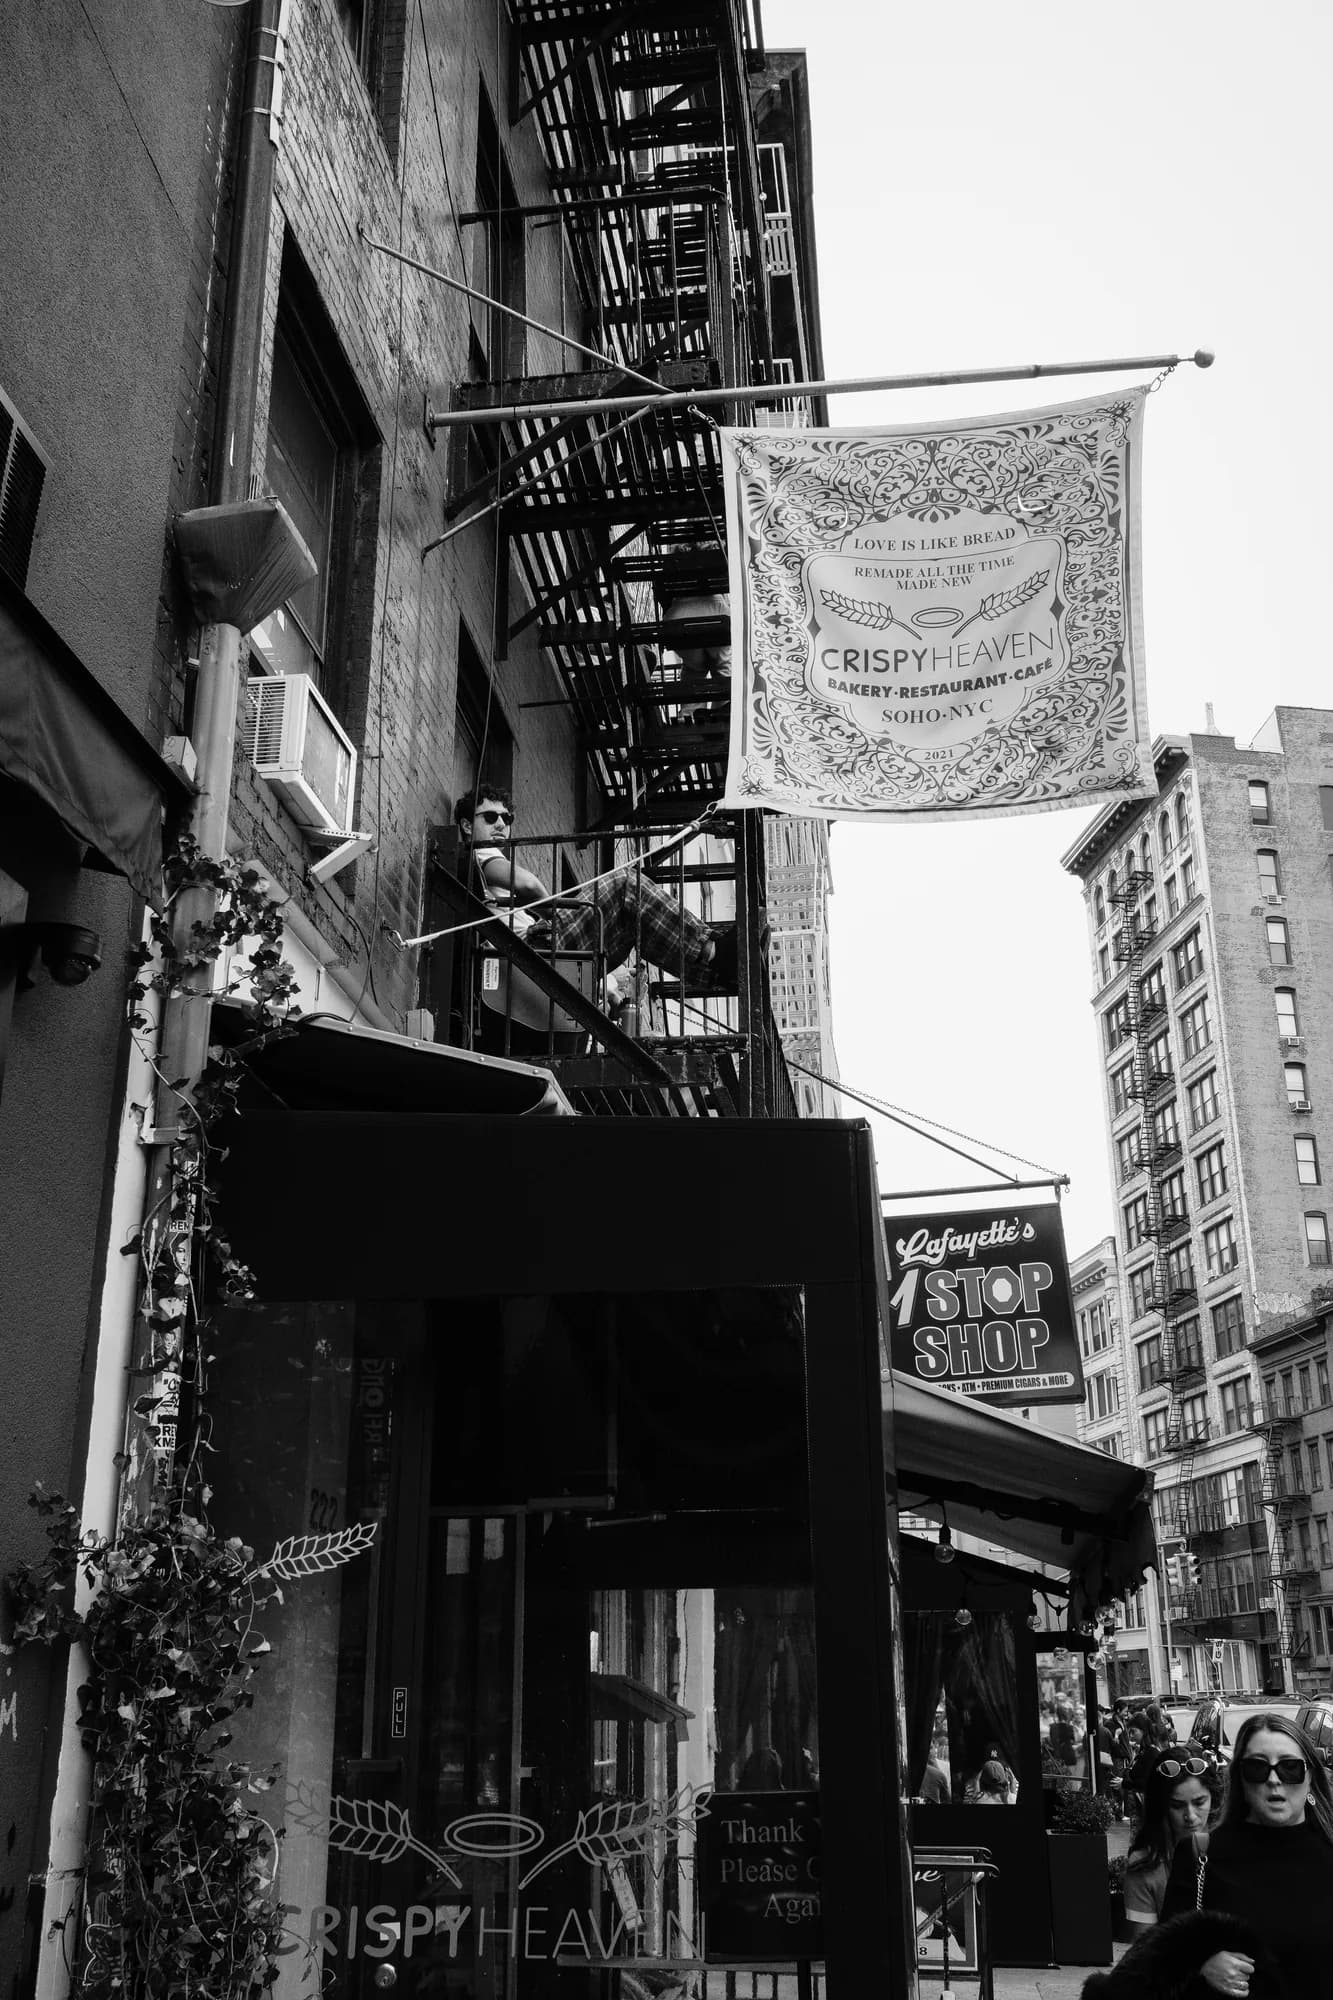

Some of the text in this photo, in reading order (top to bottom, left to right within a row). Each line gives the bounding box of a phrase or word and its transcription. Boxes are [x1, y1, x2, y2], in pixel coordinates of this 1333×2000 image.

[854, 528, 1016, 551] LOVE IS LIKE BREAD
[854, 556, 1015, 579] REMADE ALL THE TIME
[896, 576, 974, 591] MADE NEW
[925, 750, 954, 760] 2021
[896, 1217, 1035, 1267] Lafayette's
[889, 1262, 1053, 1327] 1 STOP
[913, 1318, 1049, 1378] SHOP
[961, 1382, 976, 1393] ATM
[981, 1379, 1014, 1391] PREMIUM
[1015, 1377, 1041, 1389] CIGARS
[1042, 1378, 1048, 1387] &
[1048, 1375, 1069, 1386] MORE
[395, 1691, 404, 1734] PULL
[720, 1818, 806, 1844] Thank
[720, 1857, 799, 1884] Please
[763, 1892, 822, 1925] Agai
